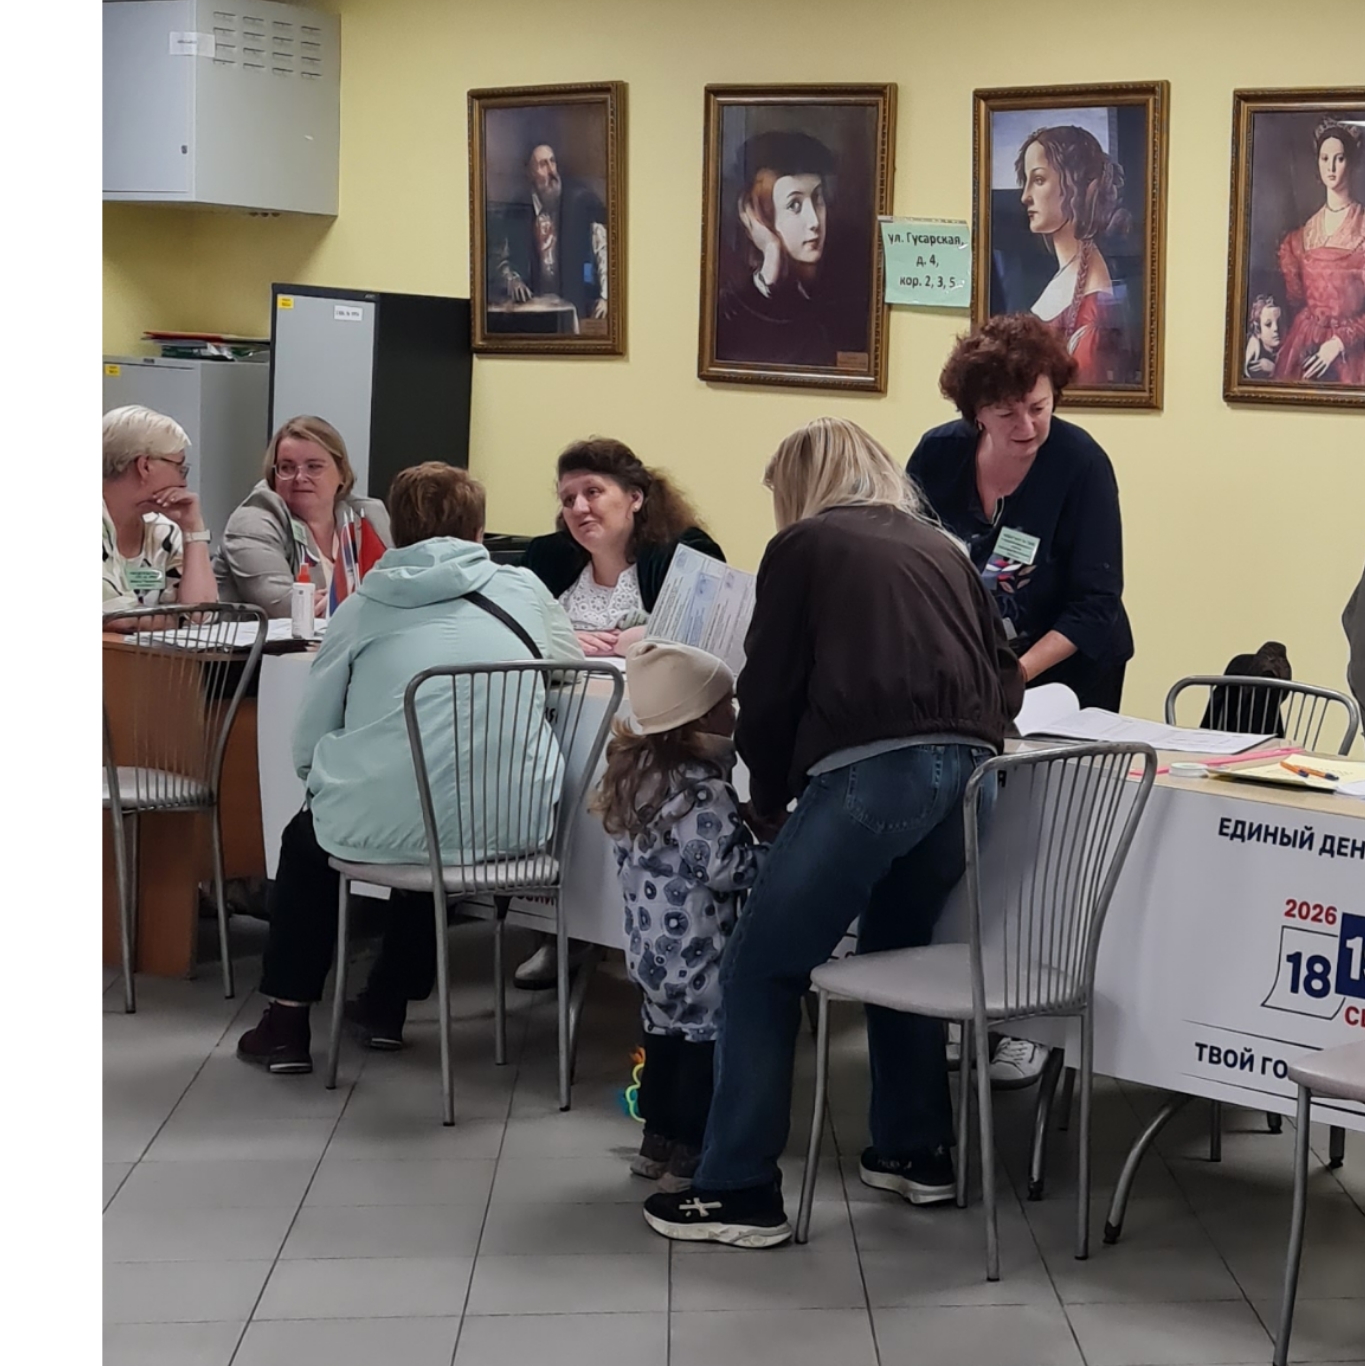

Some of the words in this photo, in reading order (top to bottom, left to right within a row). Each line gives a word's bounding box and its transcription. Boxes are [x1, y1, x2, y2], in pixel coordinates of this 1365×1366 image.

[888, 233, 904, 245] ул.
[906, 232, 964, 246] Гусарская,
[916, 255, 927, 268] д.
[929, 254, 939, 268] 4,
[899, 276, 922, 289] кор.
[925, 275, 934, 288] 2,
[937, 276, 946, 289] 3,
[1218, 817, 1315, 851] ЕДИНЫЙ
[1284, 898, 1338, 925] 2026
[1286, 951, 1332, 999] 18
[1194, 1041, 1255, 1073] ТВОЙ
[1261, 1056, 1289, 1079] ГО
